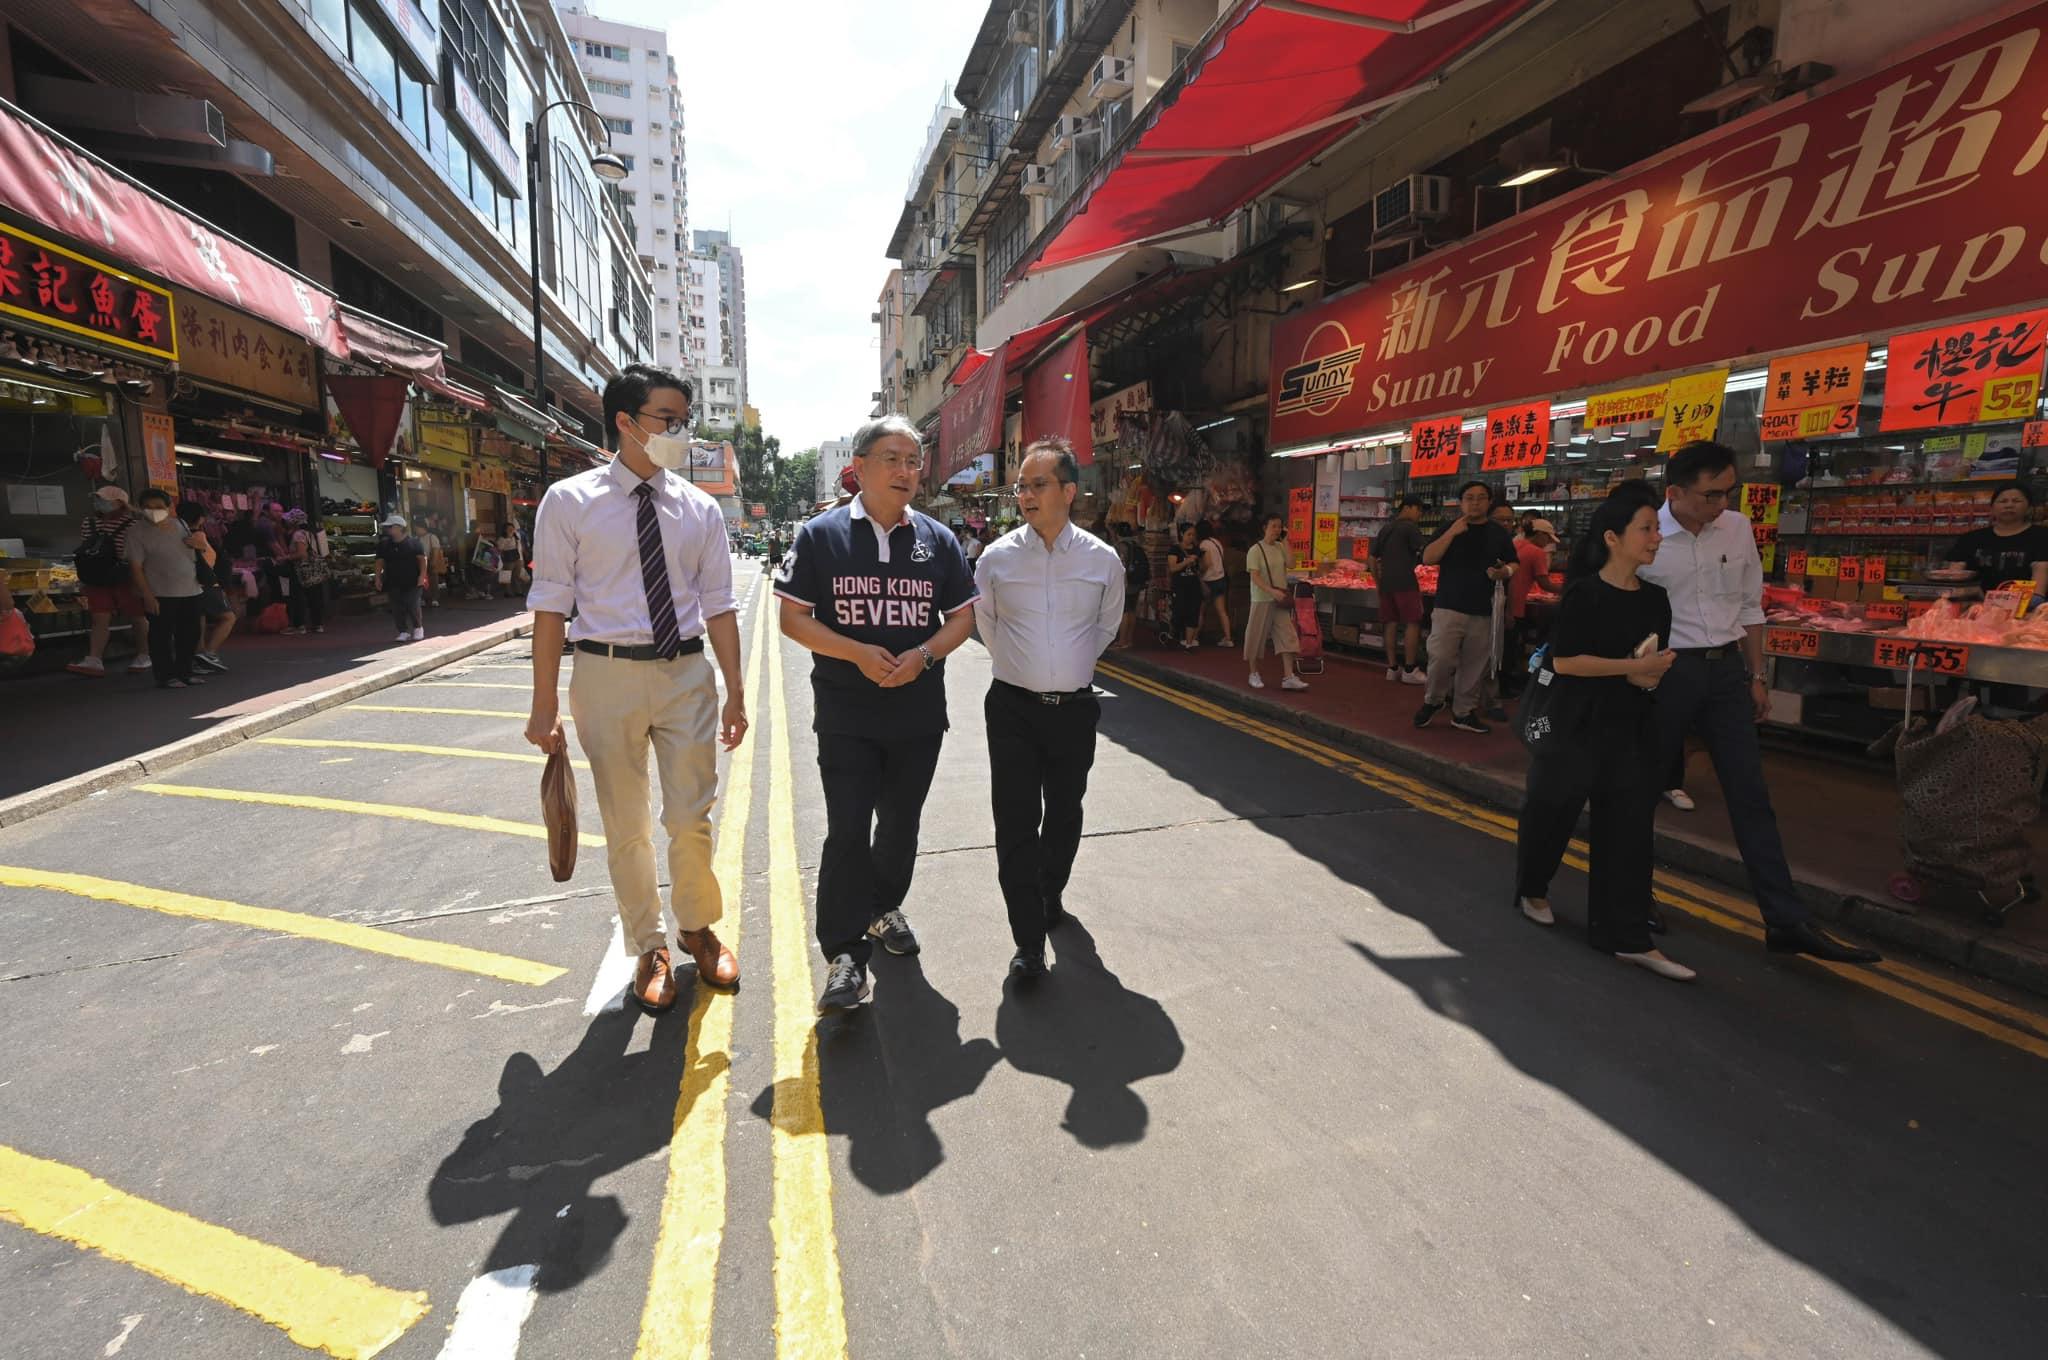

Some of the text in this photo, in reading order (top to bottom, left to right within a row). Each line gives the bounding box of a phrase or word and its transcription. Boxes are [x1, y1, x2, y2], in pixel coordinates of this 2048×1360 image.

[1374, 27, 2048, 362] 新元食品超
[1366, 356, 1495, 413] Sunny
[1543, 287, 1727, 375] Food
[1913, 320, 2042, 380] 櫻花
[1801, 366, 1851, 396] 羊粒
[1984, 380, 2033, 411] 52
[1833, 404, 1857, 429] 3
[1912, 381, 1979, 423] 牛
[1491, 410, 1536, 440] 無激素
[1762, 414, 1798, 428] GOAT
[1414, 424, 1461, 460] 燒烤
[833, 576, 934, 598] HONG KONG
[834, 599, 932, 627] SEVENS
[1800, 634, 1817, 648] 78
